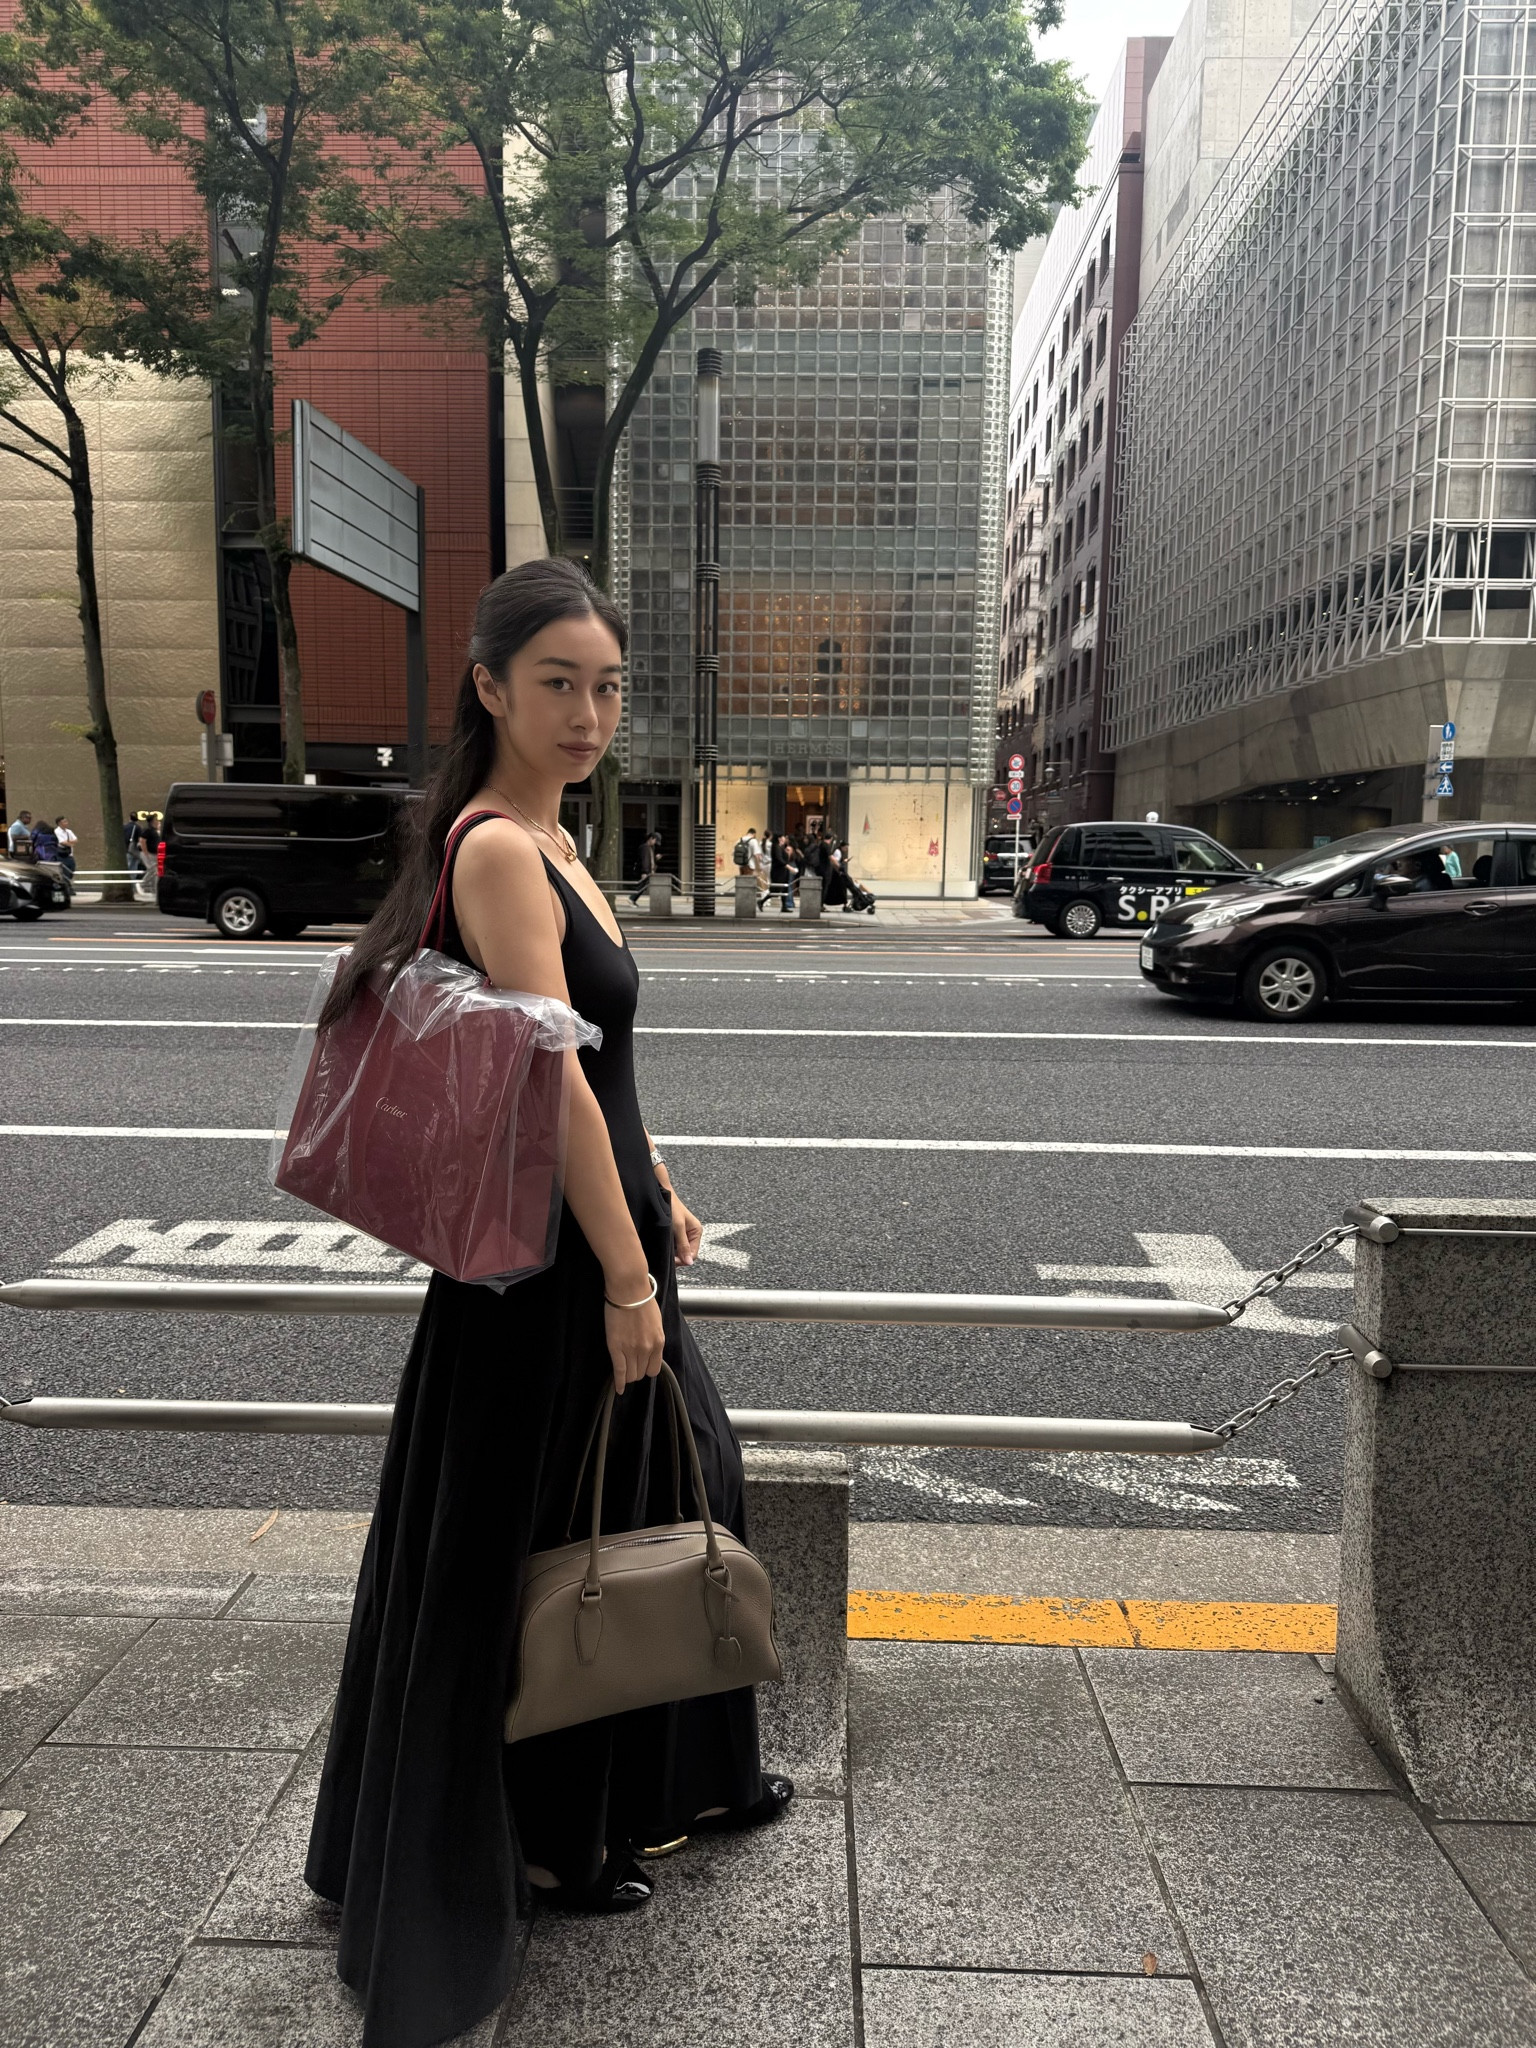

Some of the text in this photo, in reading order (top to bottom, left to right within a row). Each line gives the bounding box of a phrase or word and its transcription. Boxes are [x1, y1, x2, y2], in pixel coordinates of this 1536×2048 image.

[1119, 885, 1182, 895] タクシーアプリ
[375, 1096, 408, 1120] Cartier
